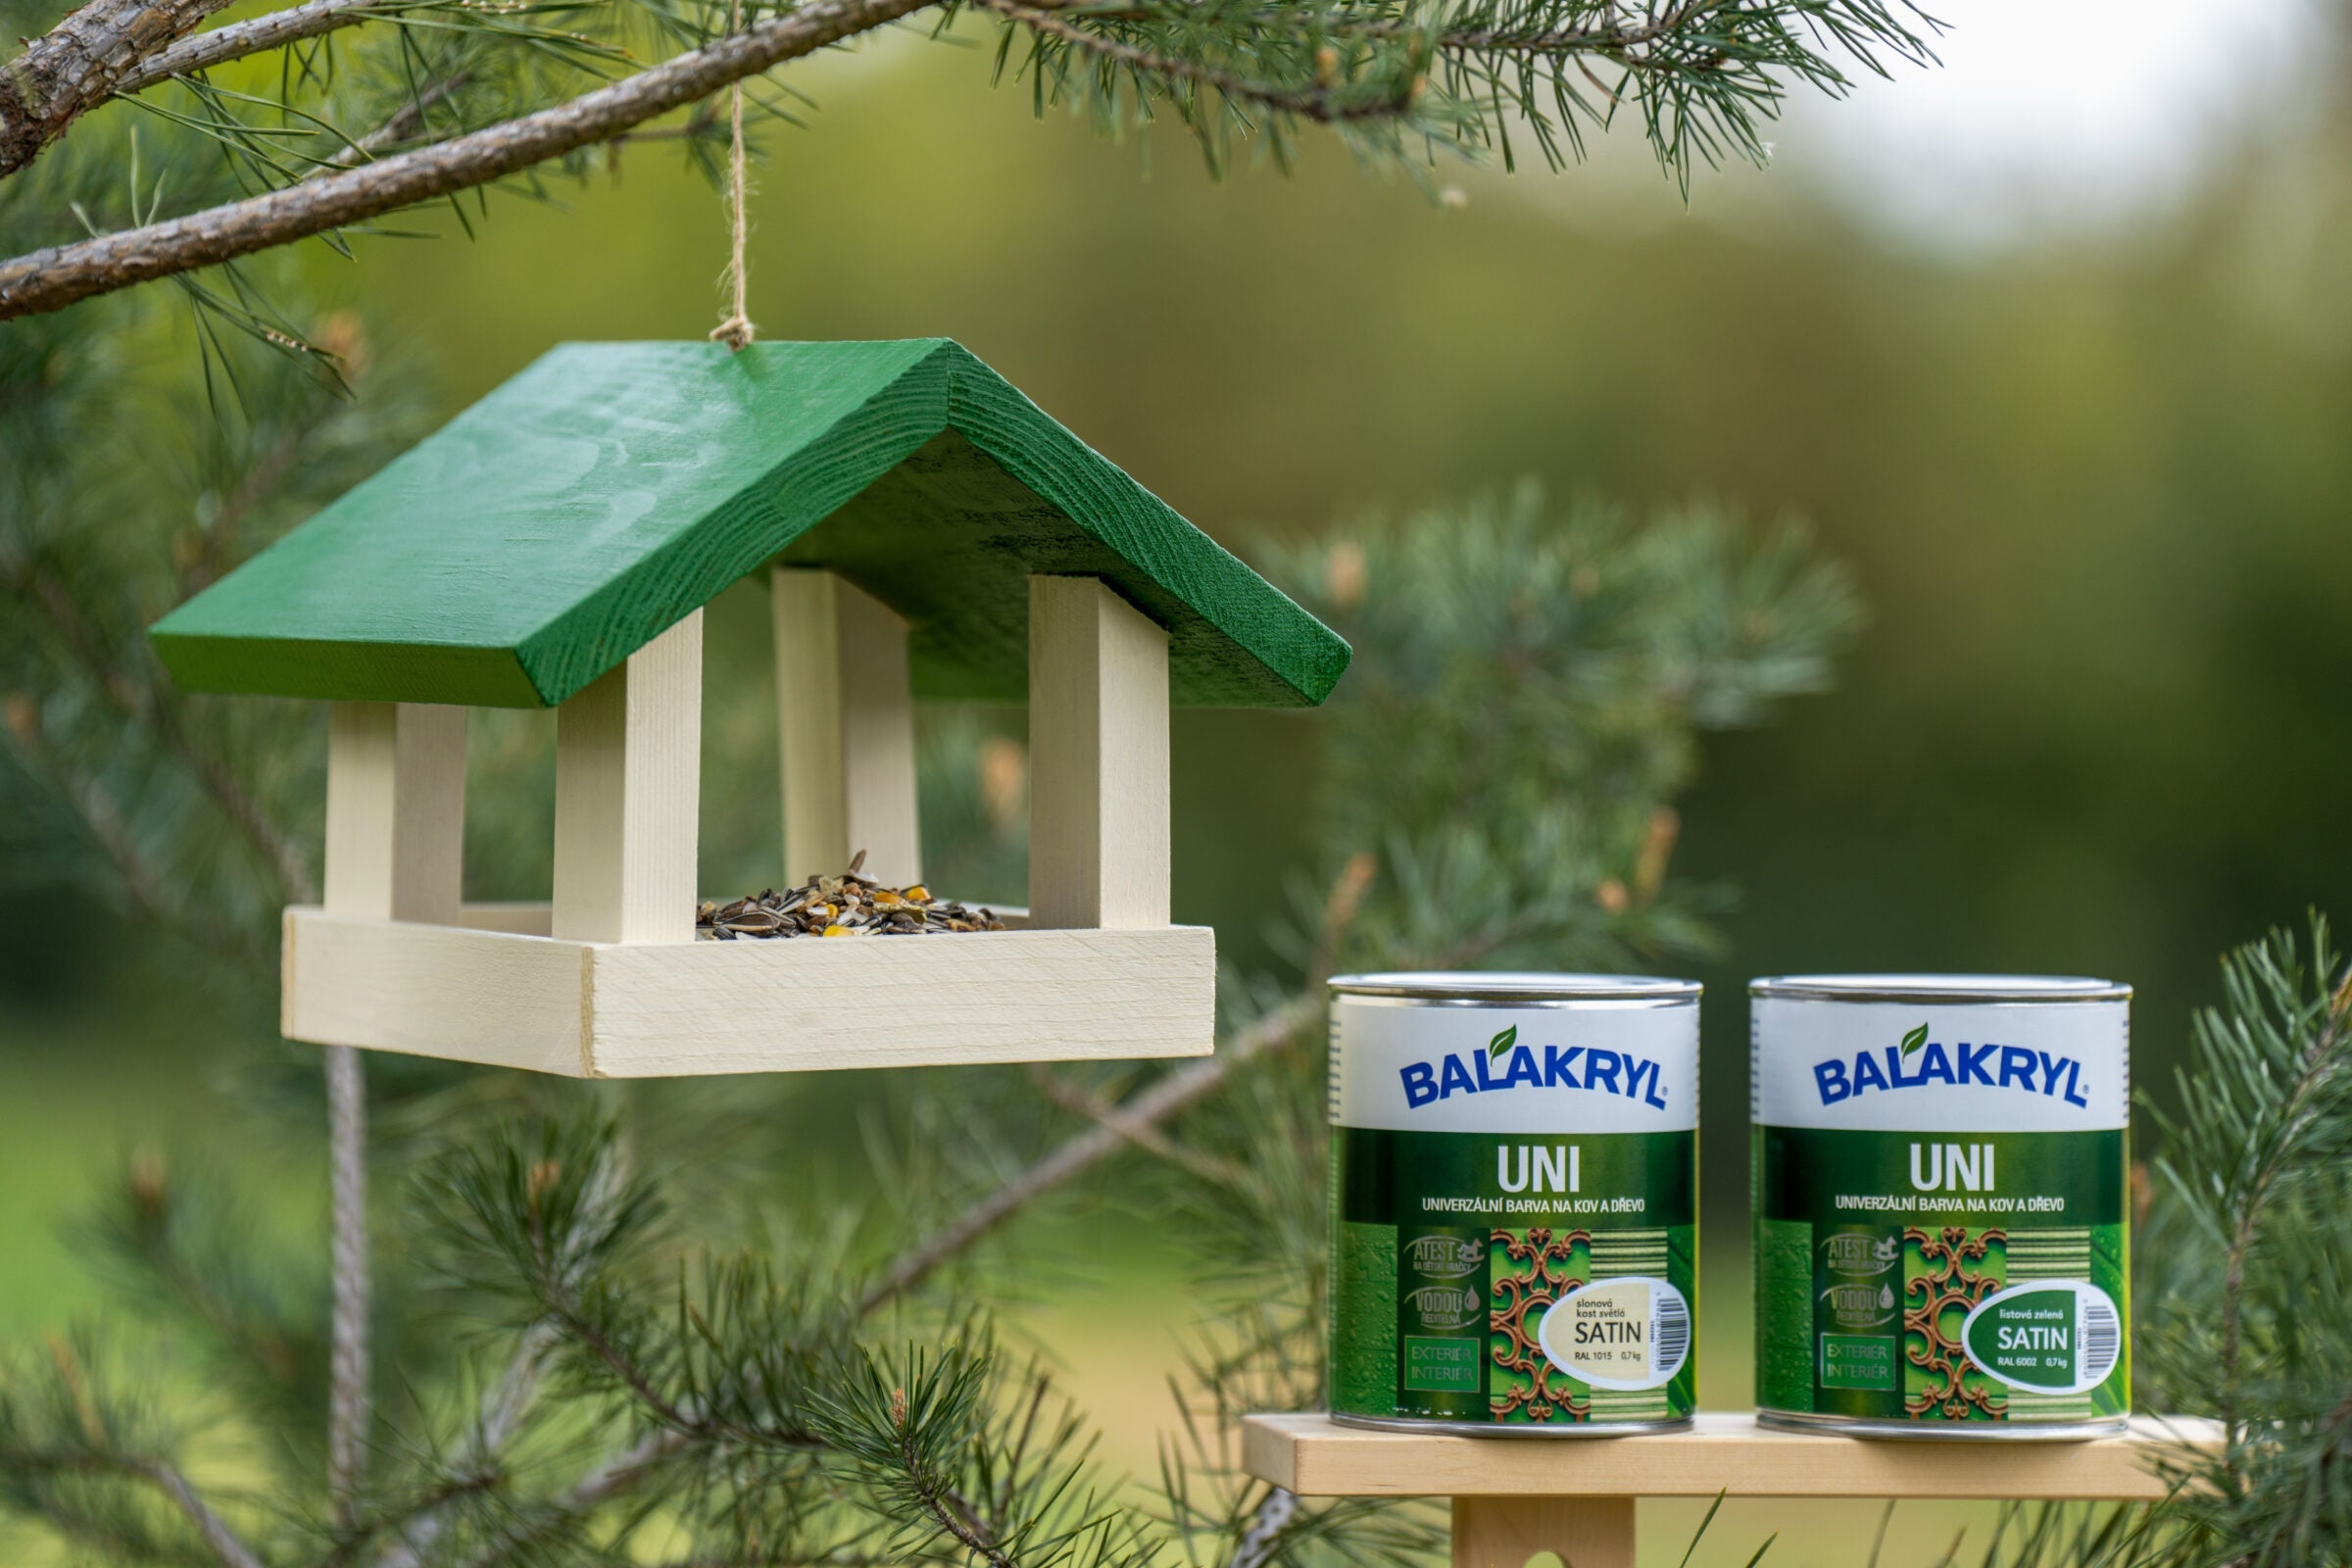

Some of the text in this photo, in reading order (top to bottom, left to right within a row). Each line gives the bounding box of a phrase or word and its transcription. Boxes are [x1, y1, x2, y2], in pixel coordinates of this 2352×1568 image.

[1497, 1146, 1580, 1193] UNI
[1910, 1144, 1994, 1192] UNI
[1422, 1197, 1644, 1213] UNIVERZÁLNÍ BARVA NA KOV A DŘEVO
[1836, 1195, 2065, 1212] UNIVERZÁLNÍ BARVA NA KOV A DŘEVO
[1414, 1240, 1455, 1261] ATEST
[1829, 1239, 1869, 1259] ATEST
[1415, 1292, 1462, 1313] VODOU
[1576, 1298, 1613, 1308] slonová
[1831, 1289, 1877, 1311] VODOU
[1576, 1307, 1626, 1317] kost světlá
[1999, 1308, 2064, 1320] listová zelená
[1574, 1321, 1641, 1344] SATIN
[1997, 1326, 2068, 1350] SATIN
[1411, 1346, 1473, 1361] EXTERIÉR
[1575, 1351, 1591, 1360] RAL
[1592, 1351, 1612, 1360] 1015
[1827, 1344, 1888, 1360] EXTERIÉR
[1997, 1356, 2015, 1366] RAL
[2016, 1357, 2037, 1367] 6002
[1411, 1365, 1474, 1381] INTERIÉR
[1827, 1363, 1889, 1380] INTERIÉR
